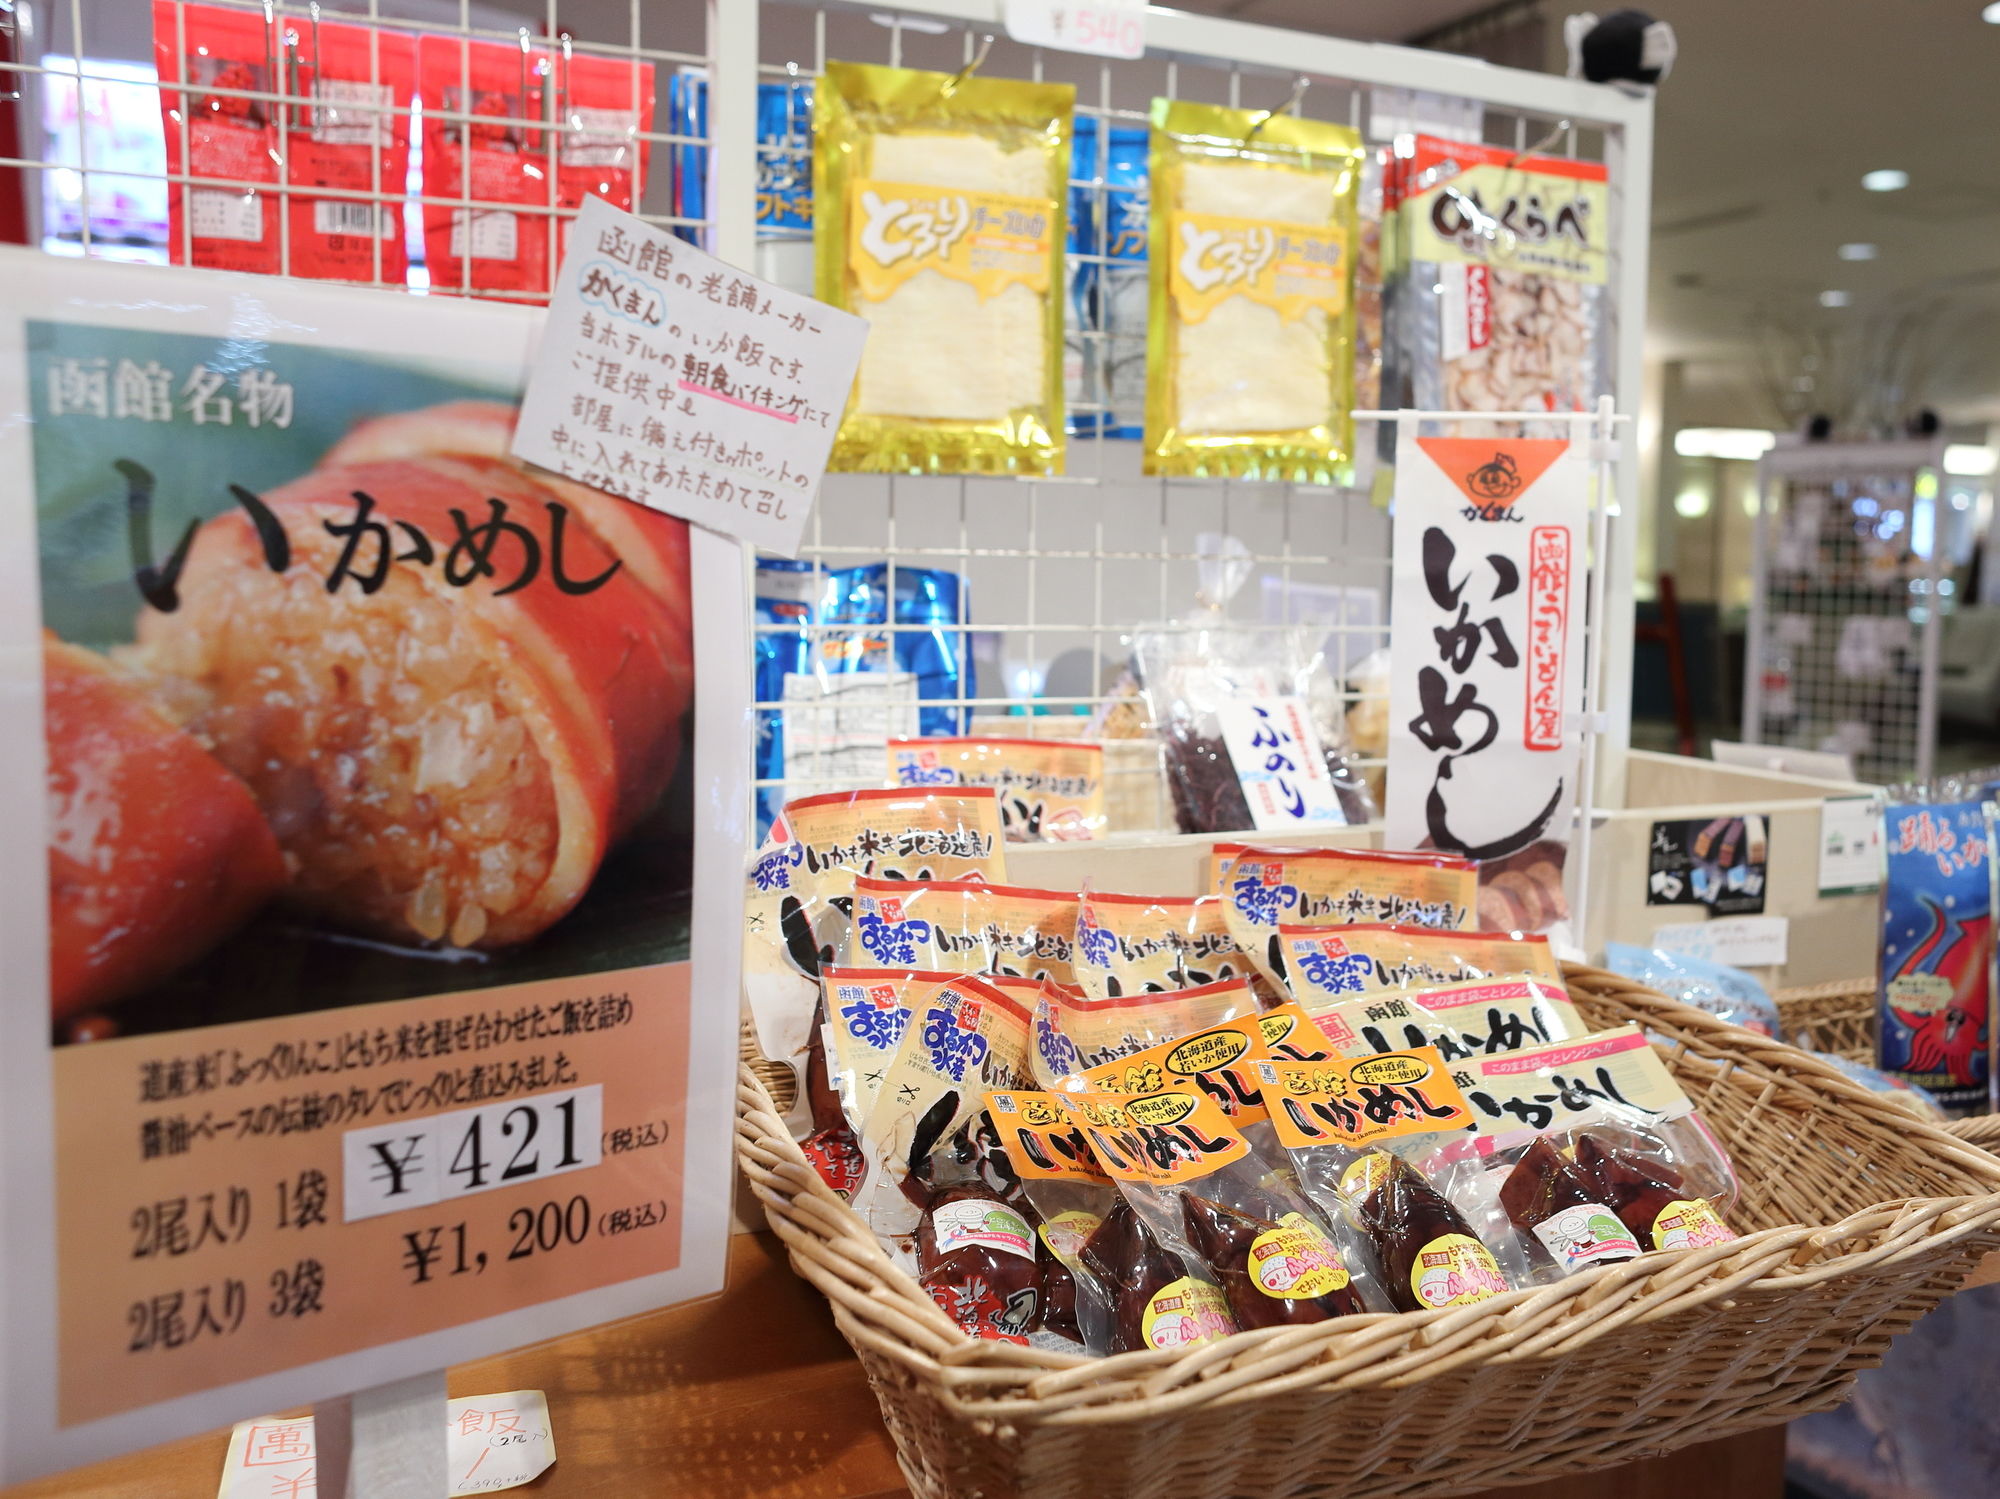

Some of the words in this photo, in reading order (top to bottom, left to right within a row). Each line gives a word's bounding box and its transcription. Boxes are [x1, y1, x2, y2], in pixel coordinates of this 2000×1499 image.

[1075, 10, 1141, 54] 540
[46, 354, 295, 430] 函館名物
[113, 458, 624, 614] いかめし
[1408, 526, 1564, 861] いかめし
[1251, 705, 1306, 819] ふのり
[1898, 811, 1956, 855] 踊る
[857, 913, 931, 950] まるかつ
[873, 944, 917, 965] 水産
[1297, 952, 1373, 985] まるかつ
[1323, 975, 1365, 995] 水産
[1365, 999, 1410, 1022] 函館
[924, 1008, 988, 1066] まるかつ
[1174, 1035, 1228, 1062] 北海道産
[930, 1049, 967, 1082] 水産
[1178, 1043, 1242, 1075] 若いか使用
[1358, 1060, 1409, 1076] 北海道産
[1129, 1096, 1173, 1114] 北海道産
[1281, 1084, 1463, 1140] いかめし
[447, 1094, 585, 1191] 421
[600, 1120, 670, 1157] (税込)
[1087, 1123, 1240, 1171] いかめし
[597, 1201, 669, 1239] (税込)
